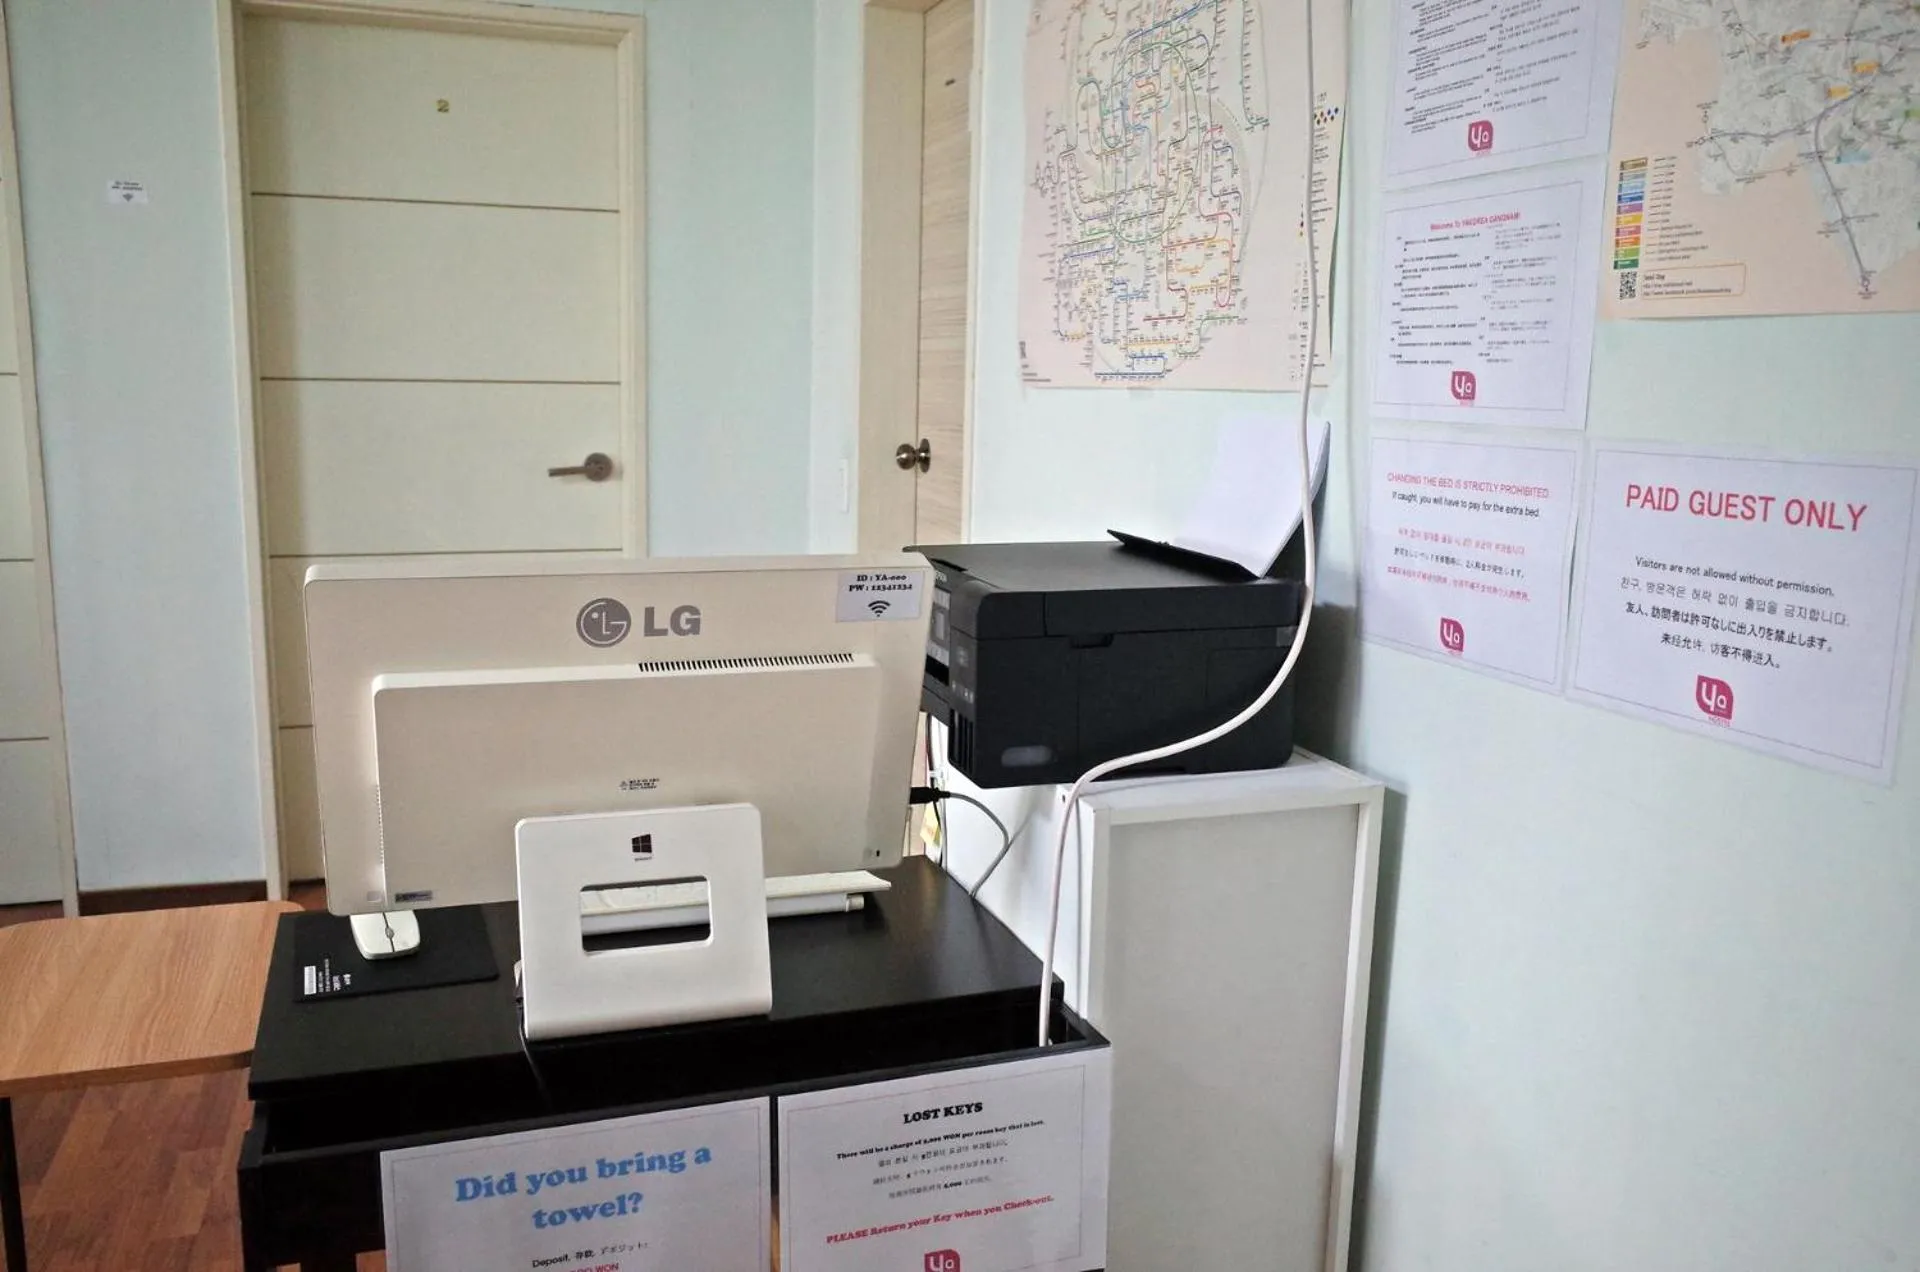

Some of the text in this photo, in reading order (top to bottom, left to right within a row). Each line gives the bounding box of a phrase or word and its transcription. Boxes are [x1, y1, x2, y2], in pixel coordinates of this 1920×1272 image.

[436, 98, 450, 113] 2
[1387, 472, 1549, 498] CHANGING THE BED IS STRICTLY PROHIBITED
[1392, 491, 1397, 499] If
[1419, 496, 1431, 505] you
[1432, 497, 1443, 505] will
[1444, 497, 1459, 508] have
[1460, 500, 1467, 508] to
[1468, 501, 1480, 512] pay
[1482, 501, 1492, 511] for
[1493, 503, 1503, 513] the
[1505, 505, 1524, 516] extra
[1626, 484, 1868, 532] PAID GUEST ONLY
[1635, 556, 1835, 597] Visitors are not allowed without permission.
[1691, 588, 1712, 603] 허락
[1718, 592, 1739, 608] 없이
[1745, 597, 1778, 615] 출입을
[644, 604, 701, 637] LG
[903, 1101, 984, 1124] LOST KEYS
[836, 1150, 859, 1161] There
[859, 1147, 874, 1156] will
[875, 1146, 884, 1154] be
[890, 1140, 914, 1152] charge
[943, 1132, 961, 1141] WON
[962, 1130, 974, 1140] per
[975, 1127, 994, 1136] room
[995, 1124, 1007, 1135] key
[1008, 1122, 1022, 1131] that
[1023, 1121, 1030, 1129] is
[455, 1147, 712, 1202] Did you bring a
[532, 1191, 644, 1230] towel?
[826, 1226, 869, 1244] PLEASE
[870, 1221, 906, 1236] Return
[907, 1215, 932, 1230] your
[933, 1208, 952, 1225] Key
[953, 1206, 982, 1220] when
[983, 1204, 1002, 1219] you
[595, 1262, 619, 1272] WON
